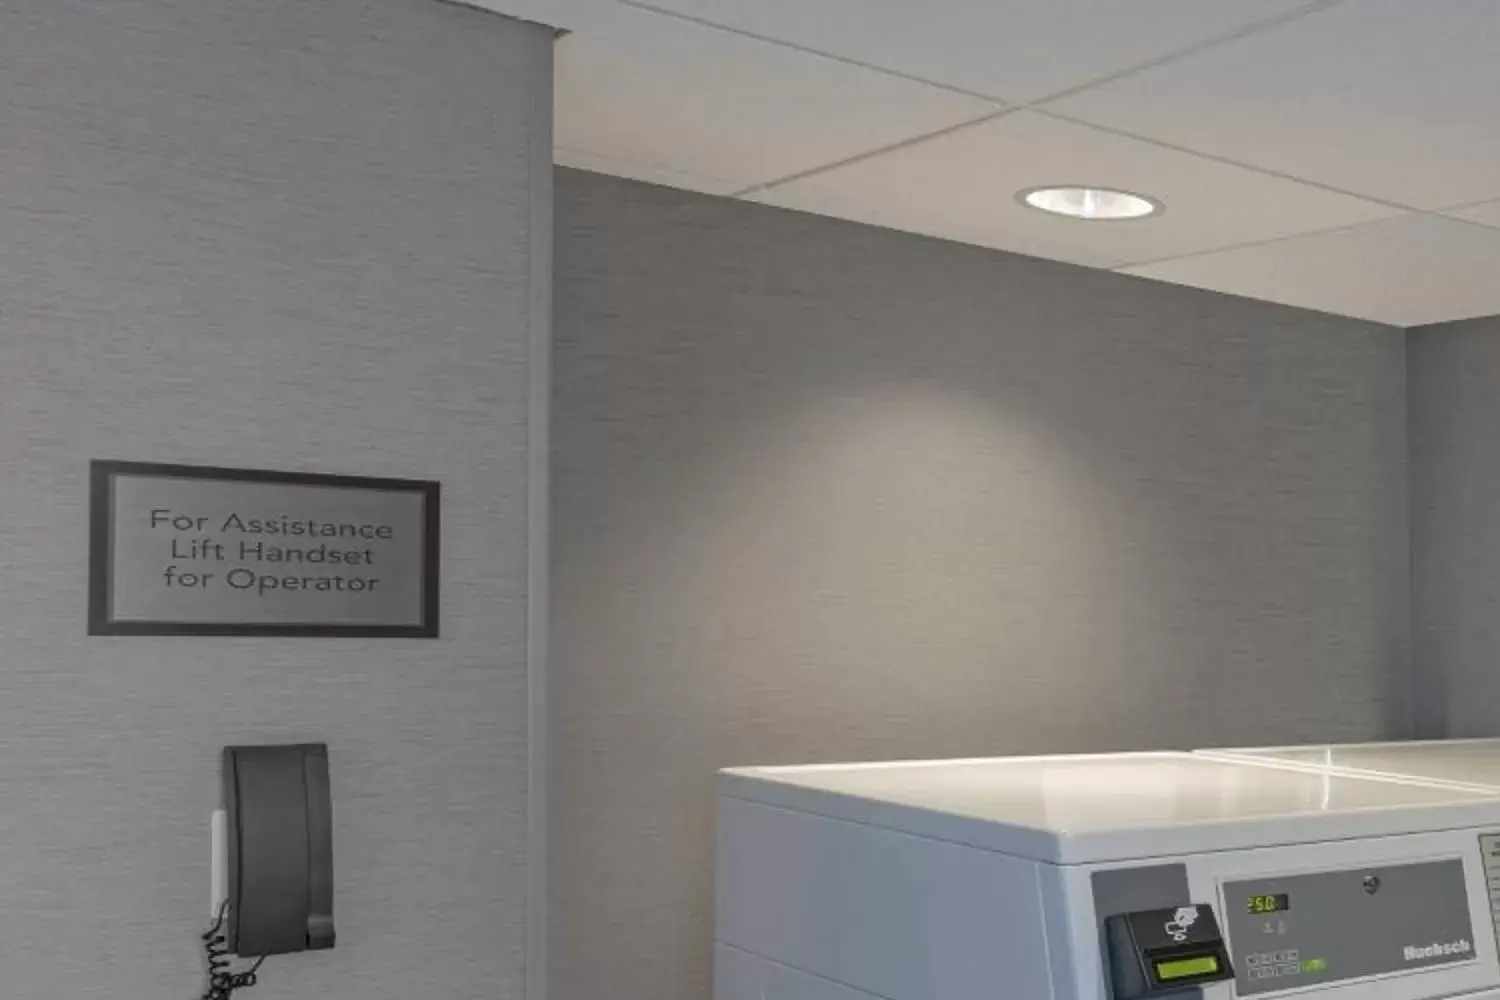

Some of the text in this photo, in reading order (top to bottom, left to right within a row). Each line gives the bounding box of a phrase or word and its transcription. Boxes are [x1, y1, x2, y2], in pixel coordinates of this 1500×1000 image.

[150, 509, 393, 540] For Assistance
[171, 538, 374, 565] Lift Handset
[163, 565, 380, 596] for Operator
